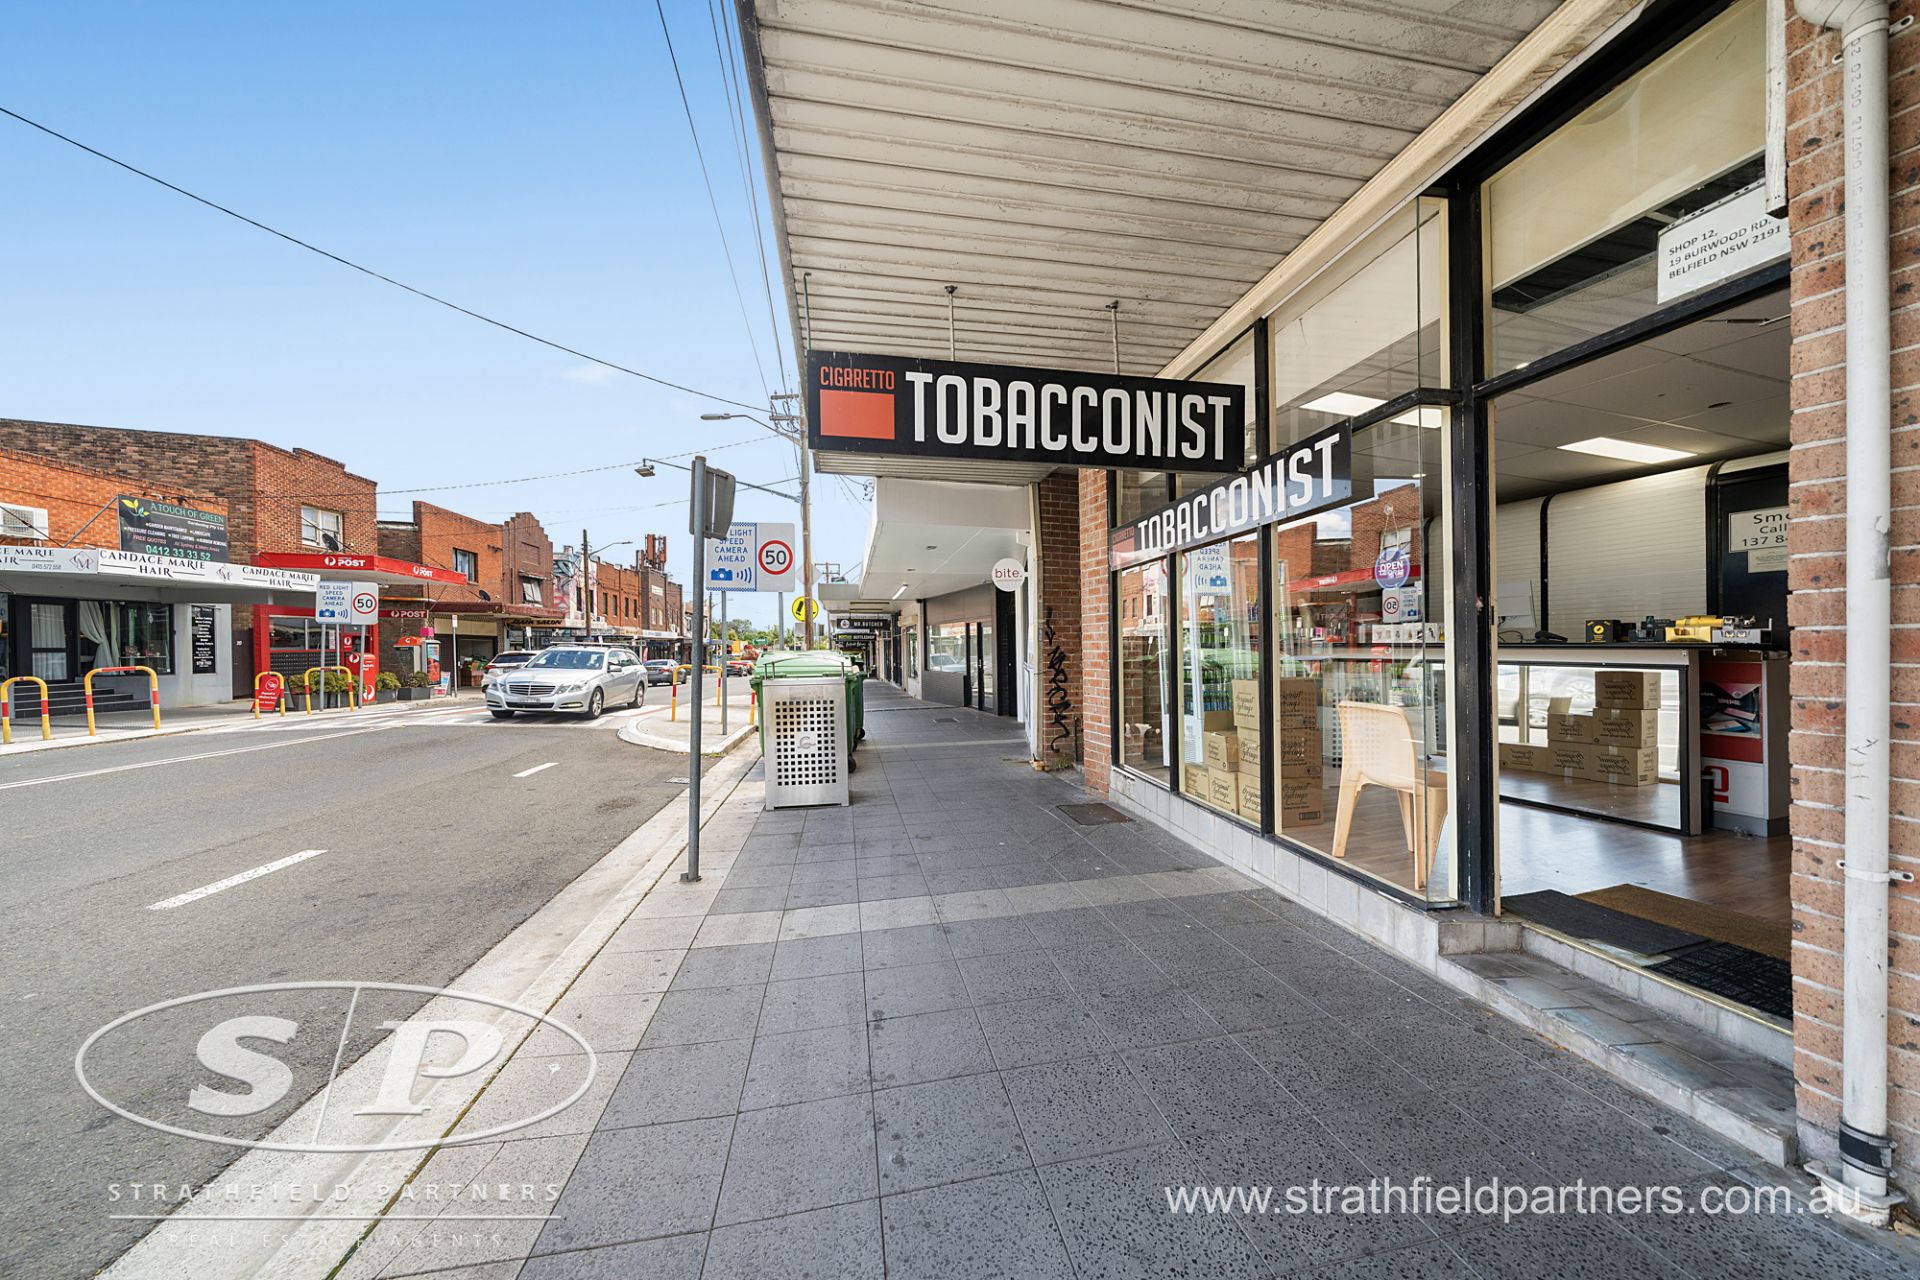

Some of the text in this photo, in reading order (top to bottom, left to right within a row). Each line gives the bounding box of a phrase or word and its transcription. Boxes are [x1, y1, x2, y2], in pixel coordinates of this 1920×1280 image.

[1669, 229, 1718, 256] SHOP 12,
[1669, 218, 1772, 268] 19 BURWOOD RD.
[1668, 225, 1782, 279] BELFIELD NSW 2191
[820, 366, 895, 391] CIGARETTO
[905, 370, 1232, 461] TOBACCONIST
[1138, 433, 1341, 552] TOBACCONIST
[159, 504, 185, 516] TOUCH
[187, 510, 198, 519] OF
[200, 512, 225, 523] GREEN
[729, 529, 753, 537] LIGHT
[1759, 523, 1788, 534] Call
[133, 534, 146, 542] FREE
[719, 537, 745, 545] SPEED
[1741, 534, 1788, 547] 137 8
[15, 549, 55, 557] MARIE
[145, 544, 212, 561] 0412 33 33 52
[714, 546, 749, 554] CAMERA
[99, 549, 206, 571] CANDACE MARIE
[337, 559, 366, 567] POST
[717, 555, 746, 563] AHEAD
[765, 550, 787, 565] 50
[139, 565, 174, 578] HAIR
[1379, 560, 1404, 572] OPEN
[242, 566, 315, 582] CANDACE MARIE
[994, 567, 1023, 579] bite.
[269, 578, 293, 588] HAIR
[356, 598, 374, 609] 50
[400, 610, 426, 618] POST
